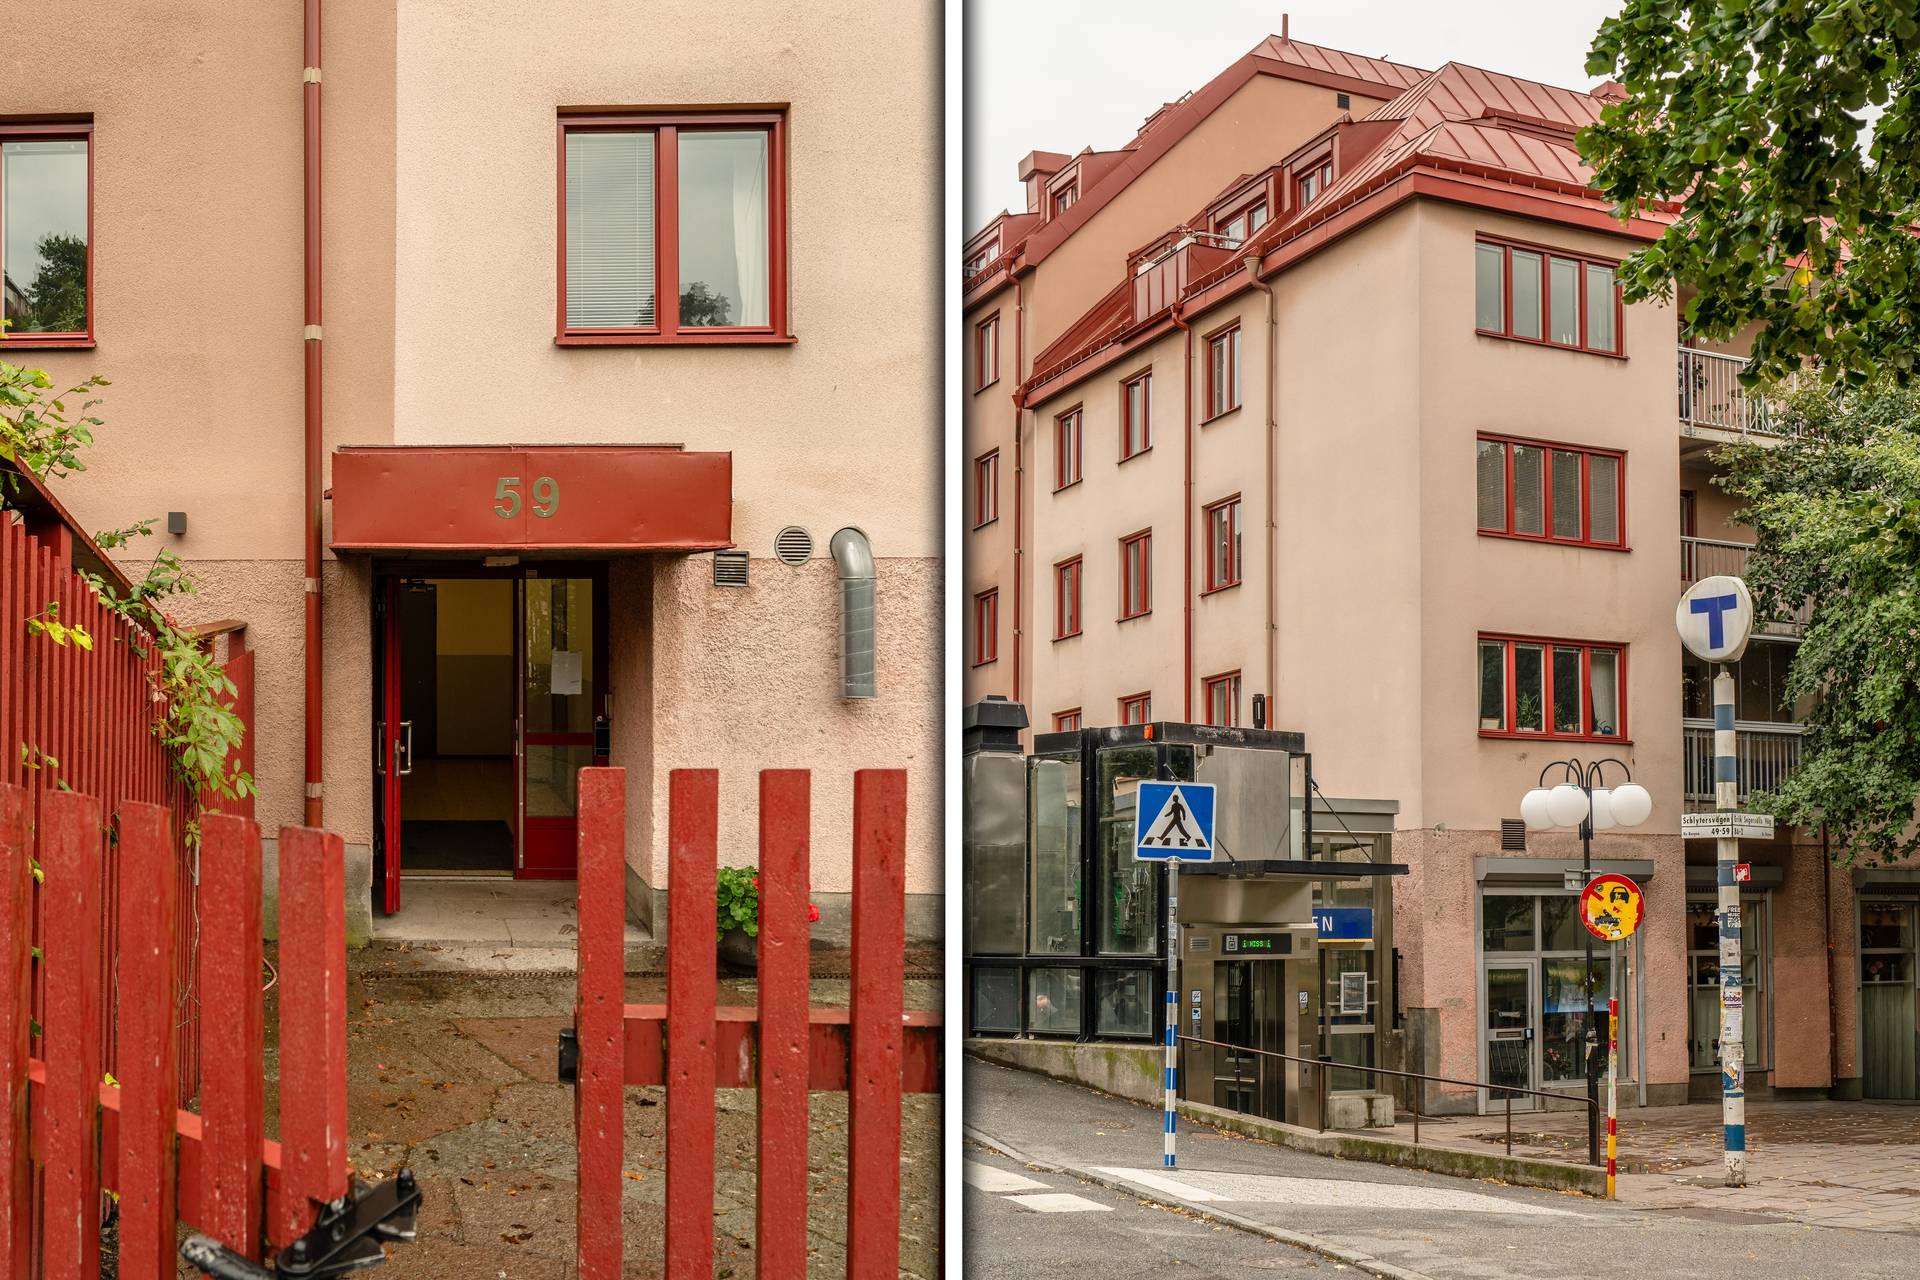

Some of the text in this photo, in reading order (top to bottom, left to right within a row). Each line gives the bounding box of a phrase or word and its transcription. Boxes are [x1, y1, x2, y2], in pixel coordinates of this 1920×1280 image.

[494, 477, 560, 519] 59
[1690, 594, 1737, 650] T
[1683, 816, 1730, 826] Schlytersvägen
[1711, 827, 1730, 835] 49-59
